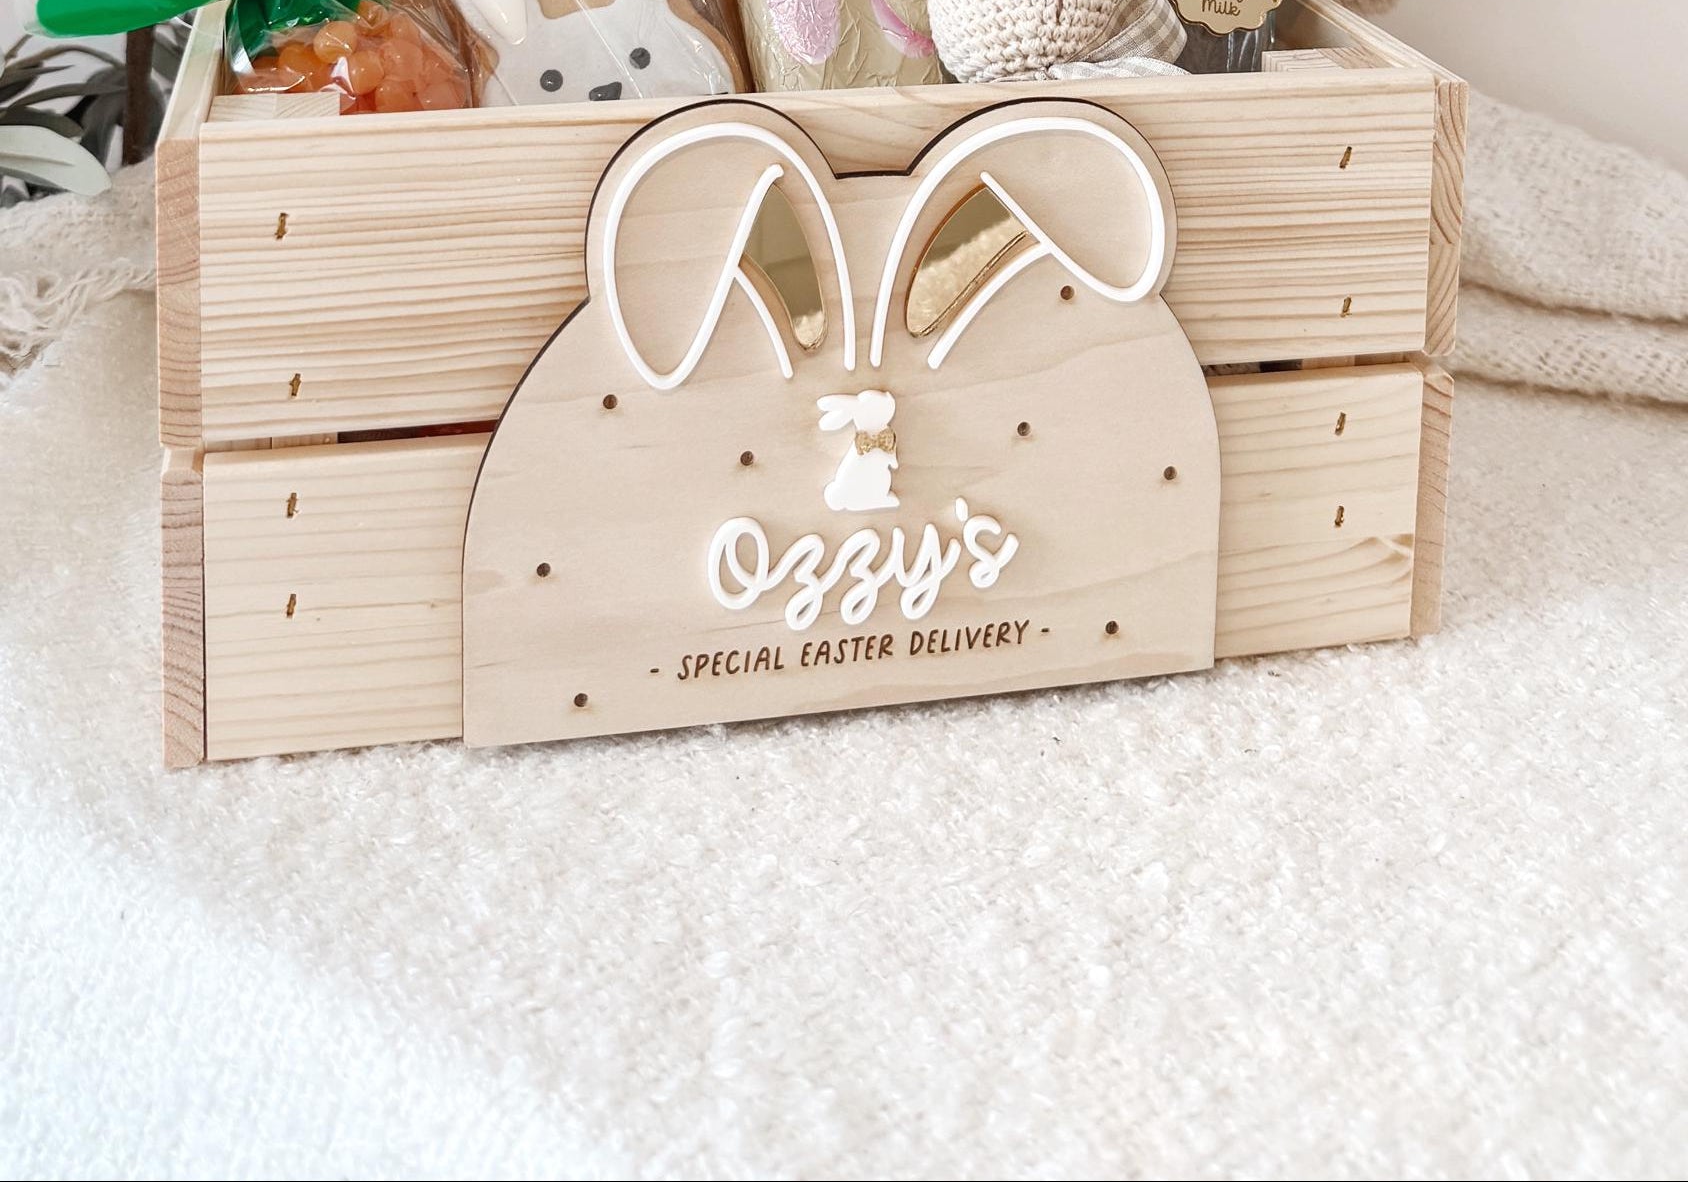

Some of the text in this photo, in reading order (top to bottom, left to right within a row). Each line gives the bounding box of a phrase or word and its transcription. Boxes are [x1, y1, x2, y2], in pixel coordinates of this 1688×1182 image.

[707, 497, 1019, 630] Ozzy's
[677, 645, 785, 680] SPECIAL
[800, 633, 894, 668] EASTER
[909, 619, 1030, 656] DELIVERY
